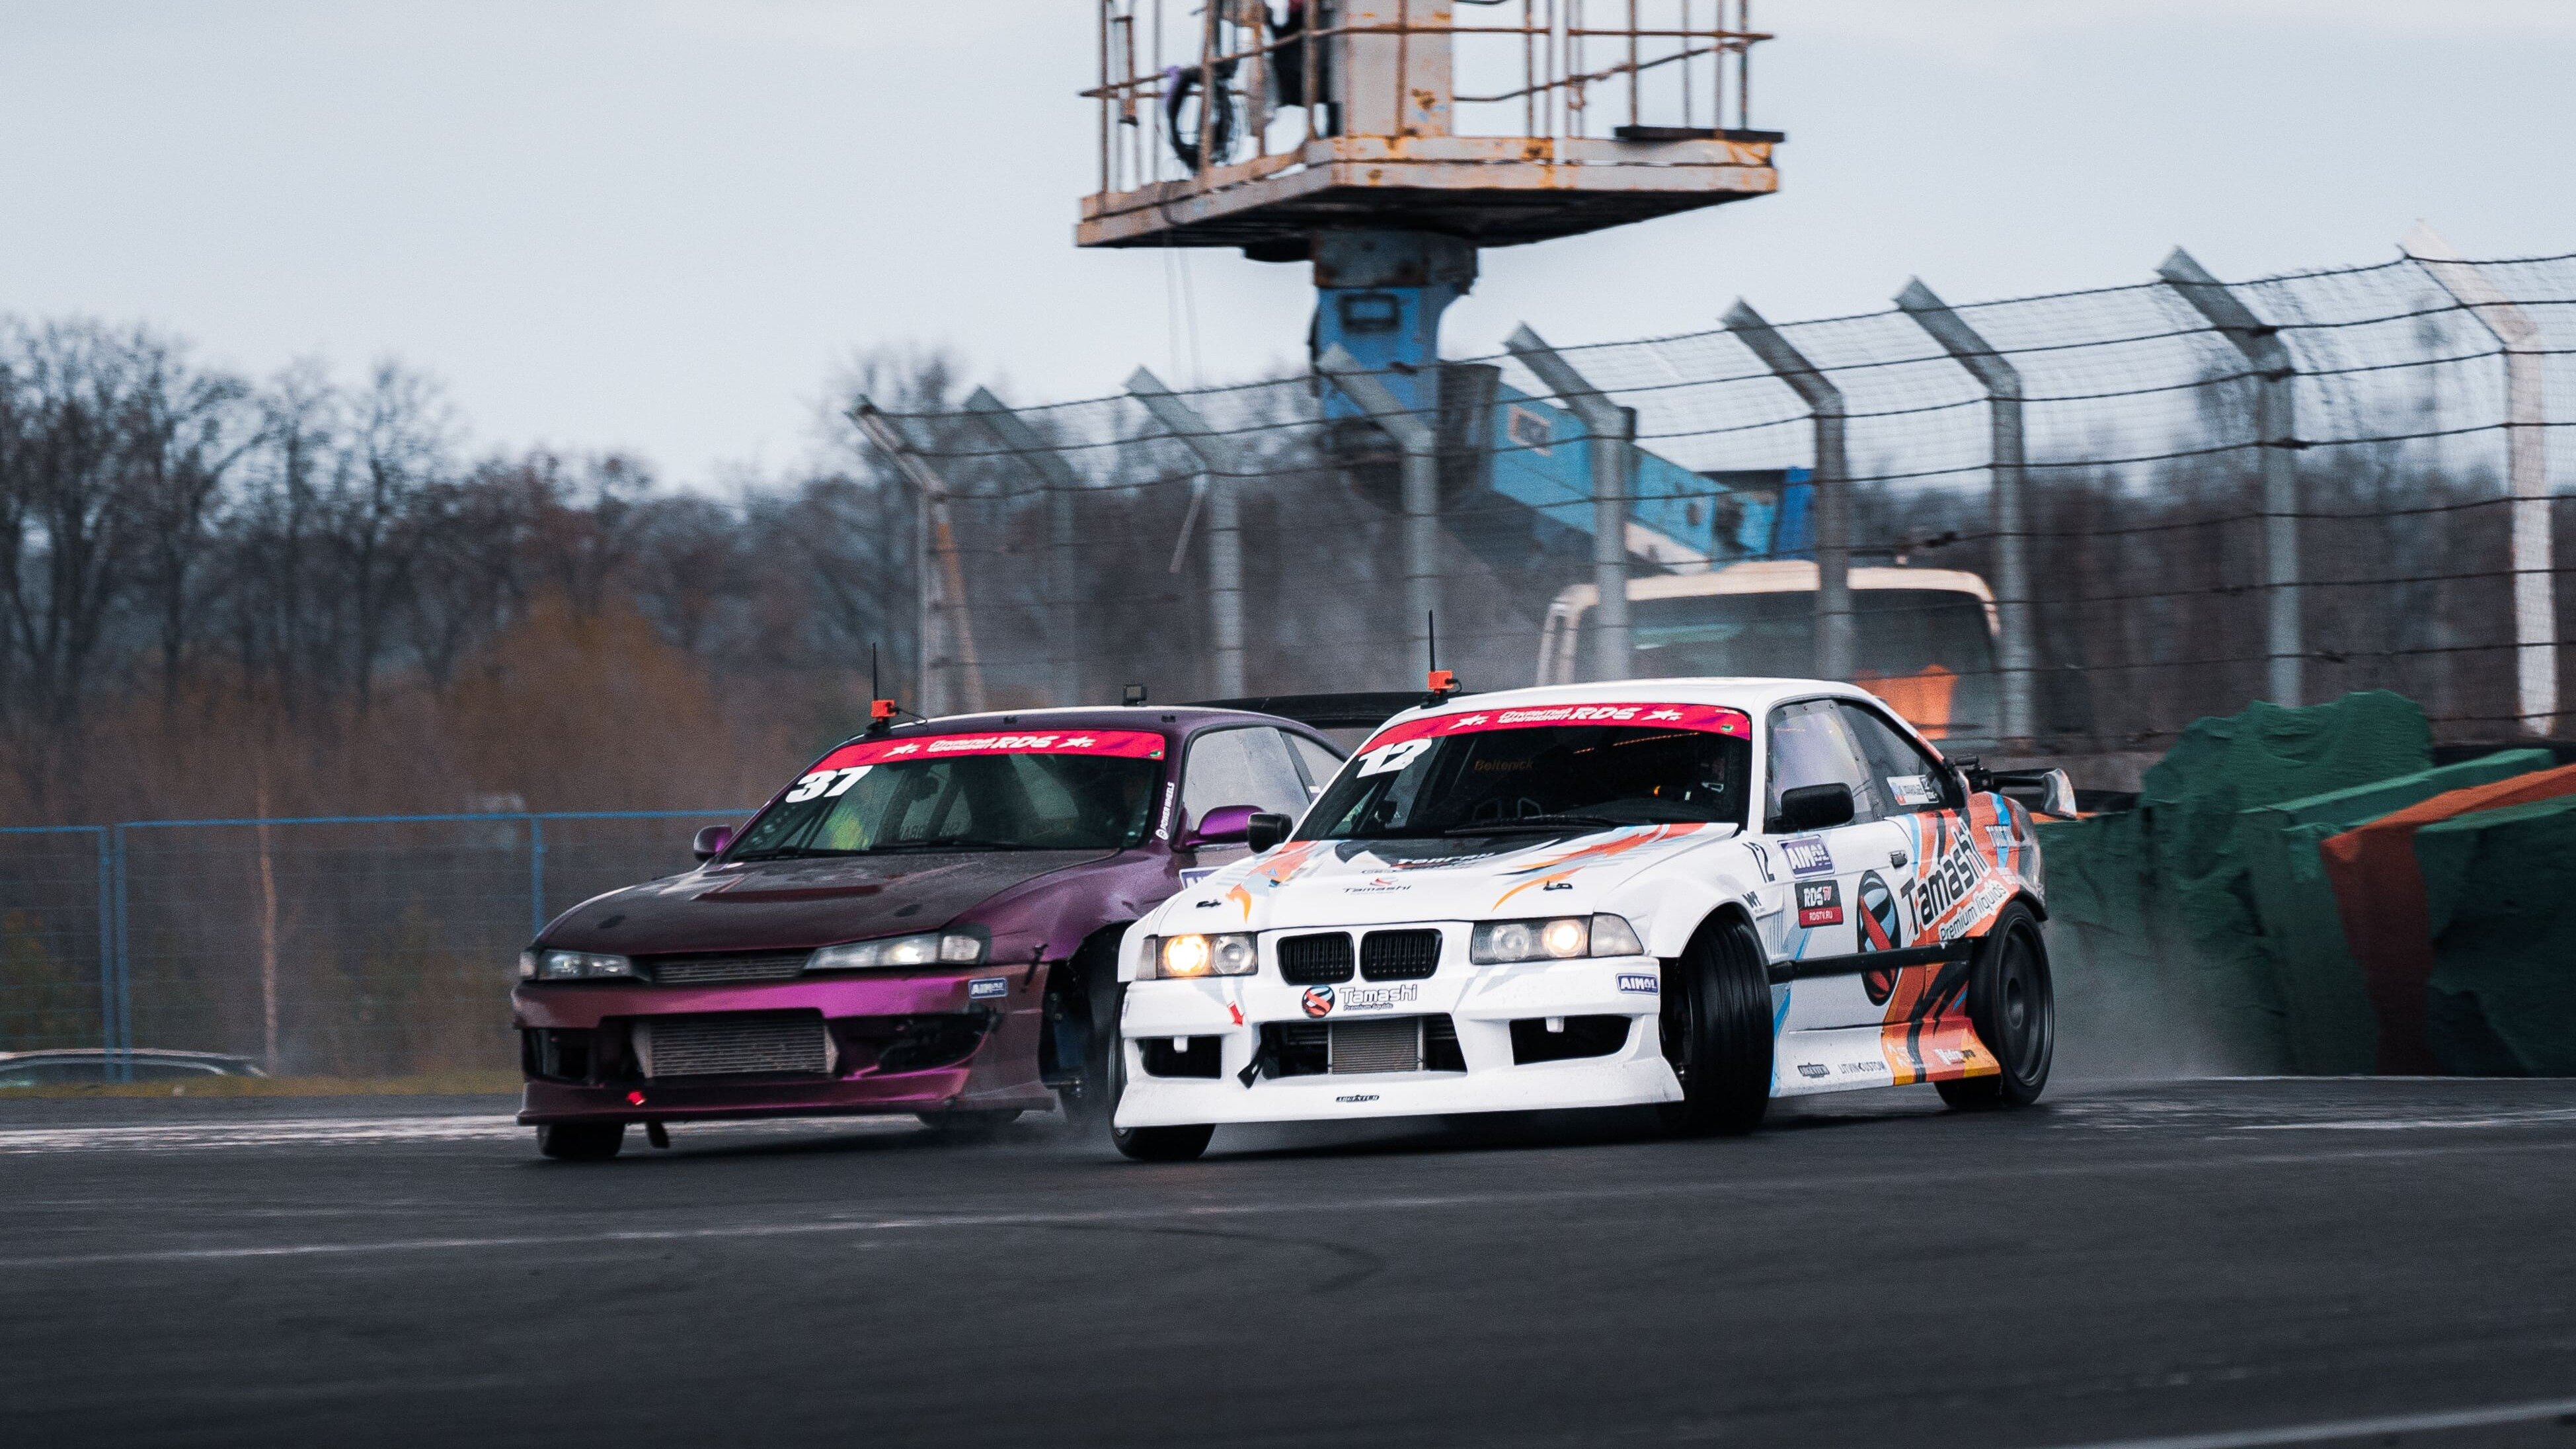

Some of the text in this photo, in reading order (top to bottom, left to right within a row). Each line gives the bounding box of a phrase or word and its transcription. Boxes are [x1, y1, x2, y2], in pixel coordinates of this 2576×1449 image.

[1569, 707, 1643, 720] RDS
[991, 736, 1060, 749] RDS
[1356, 738, 1432, 778] 12
[785, 765, 873, 803] 37
[1742, 842, 1776, 883] 12
[1900, 821, 1988, 935] Tamashi
[1941, 883, 2006, 940] Premium liquids
[1339, 984, 1417, 1003] Tamashi
